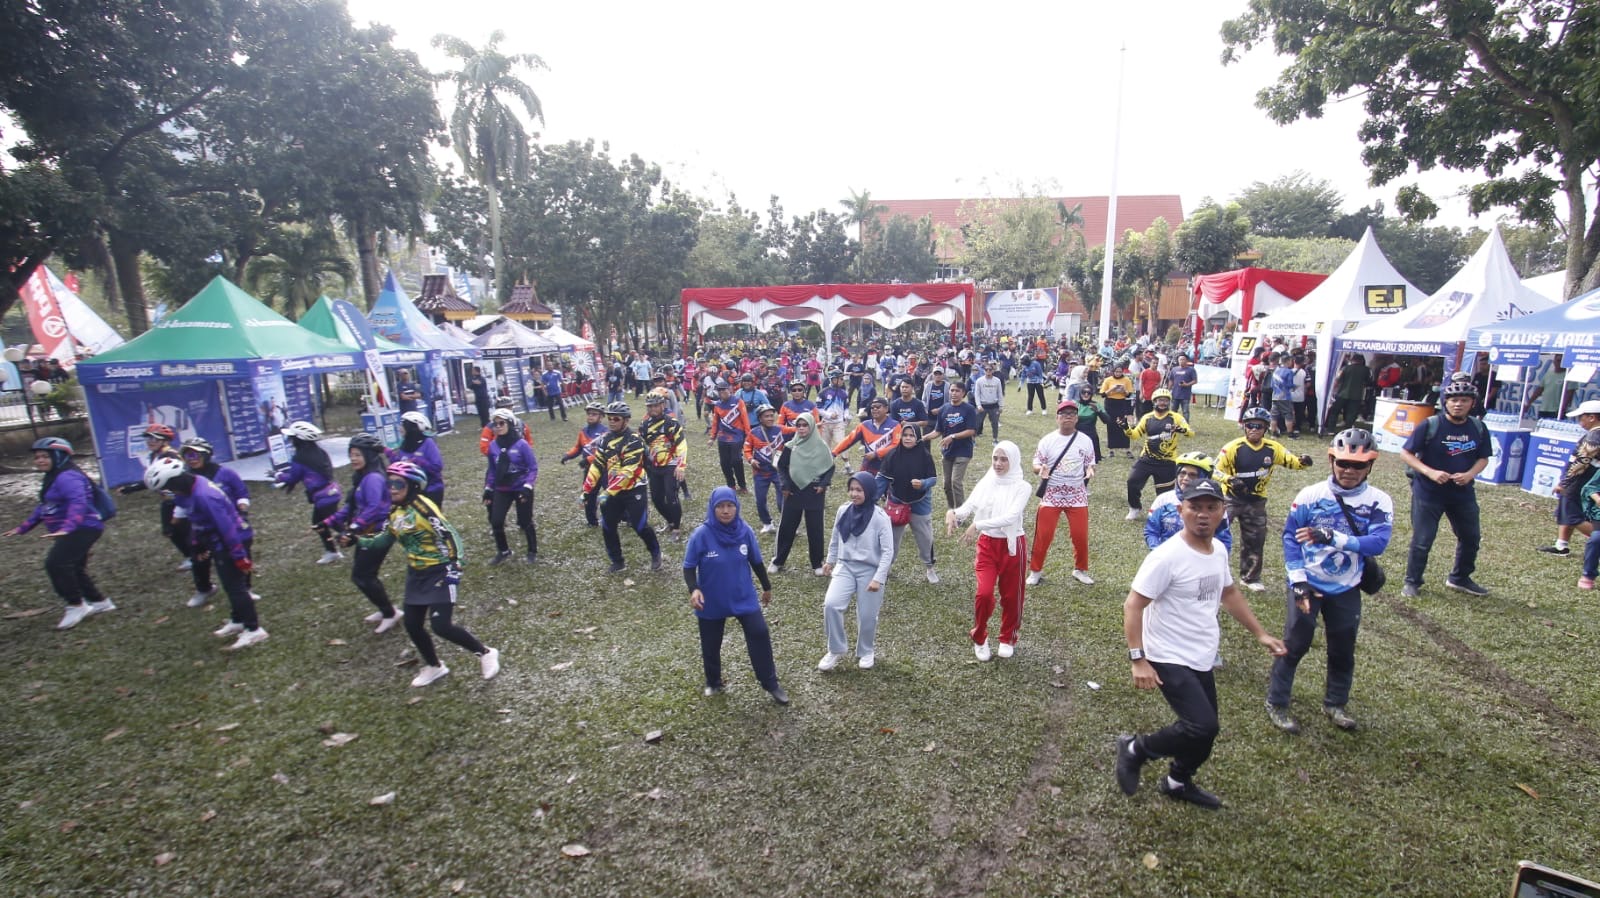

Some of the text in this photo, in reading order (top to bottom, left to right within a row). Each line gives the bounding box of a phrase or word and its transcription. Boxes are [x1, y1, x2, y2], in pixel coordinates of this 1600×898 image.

[1368, 289, 1403, 308] EJ
[1239, 338, 1256, 351] EJ
[1353, 341, 1396, 352] PEKANBARU
[1398, 343, 1441, 354] SUDIRMAN
[105, 366, 153, 378] Salonpas
